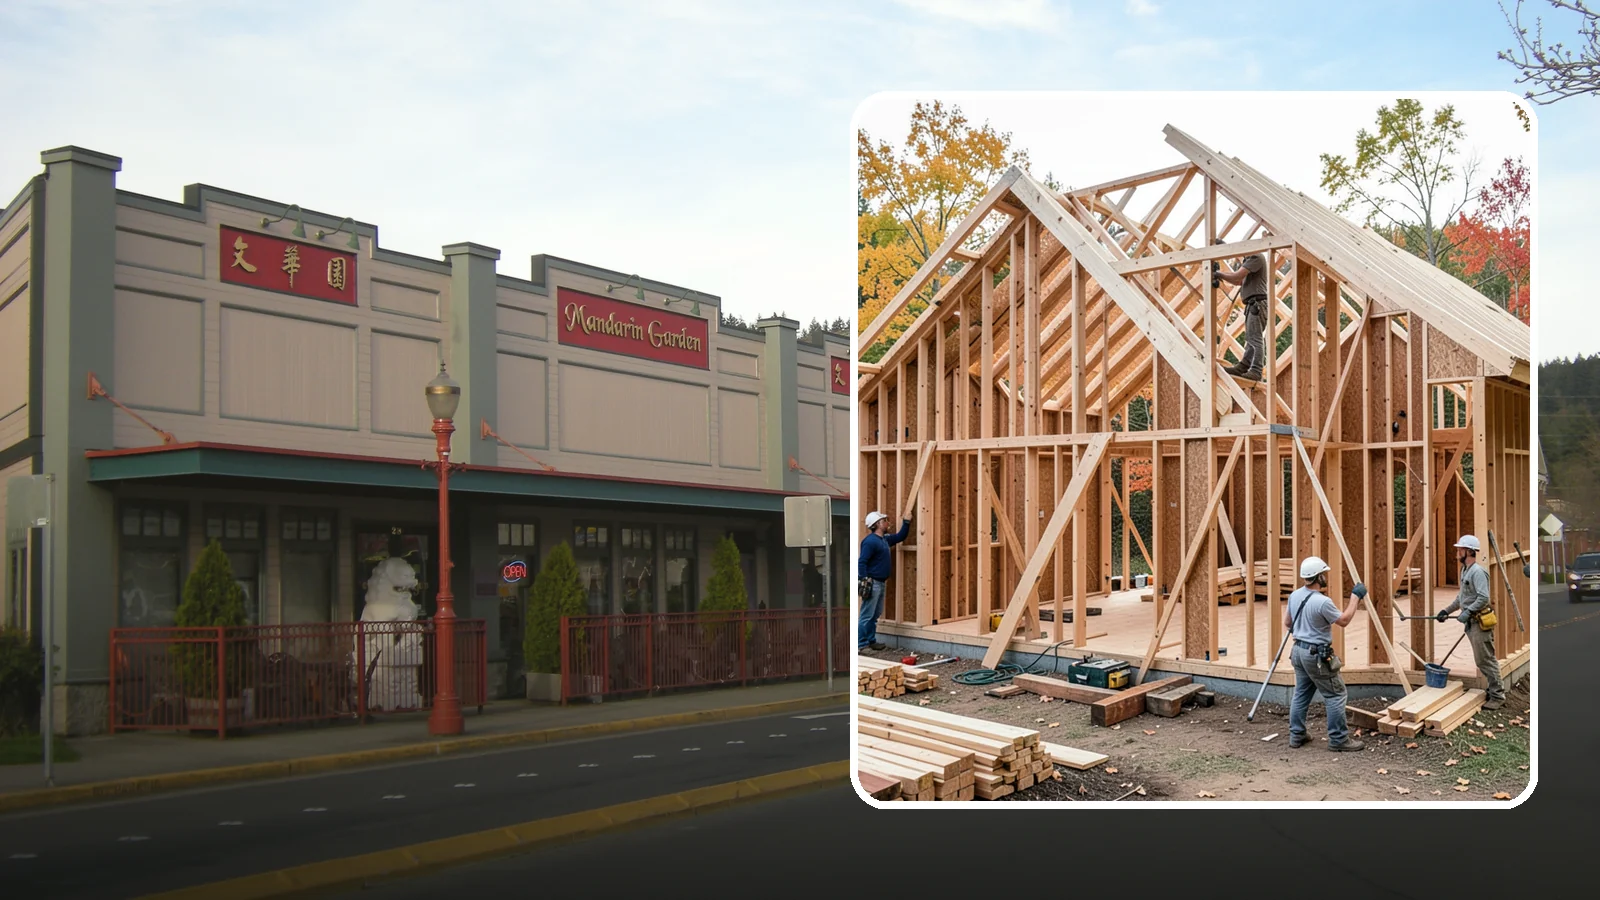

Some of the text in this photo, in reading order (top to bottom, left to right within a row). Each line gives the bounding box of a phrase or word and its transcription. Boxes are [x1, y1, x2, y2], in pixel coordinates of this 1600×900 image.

[231, 236, 346, 291] 文華園
[564, 302, 701, 352] Mandarin Garden
[503, 565, 527, 578] OPEN
